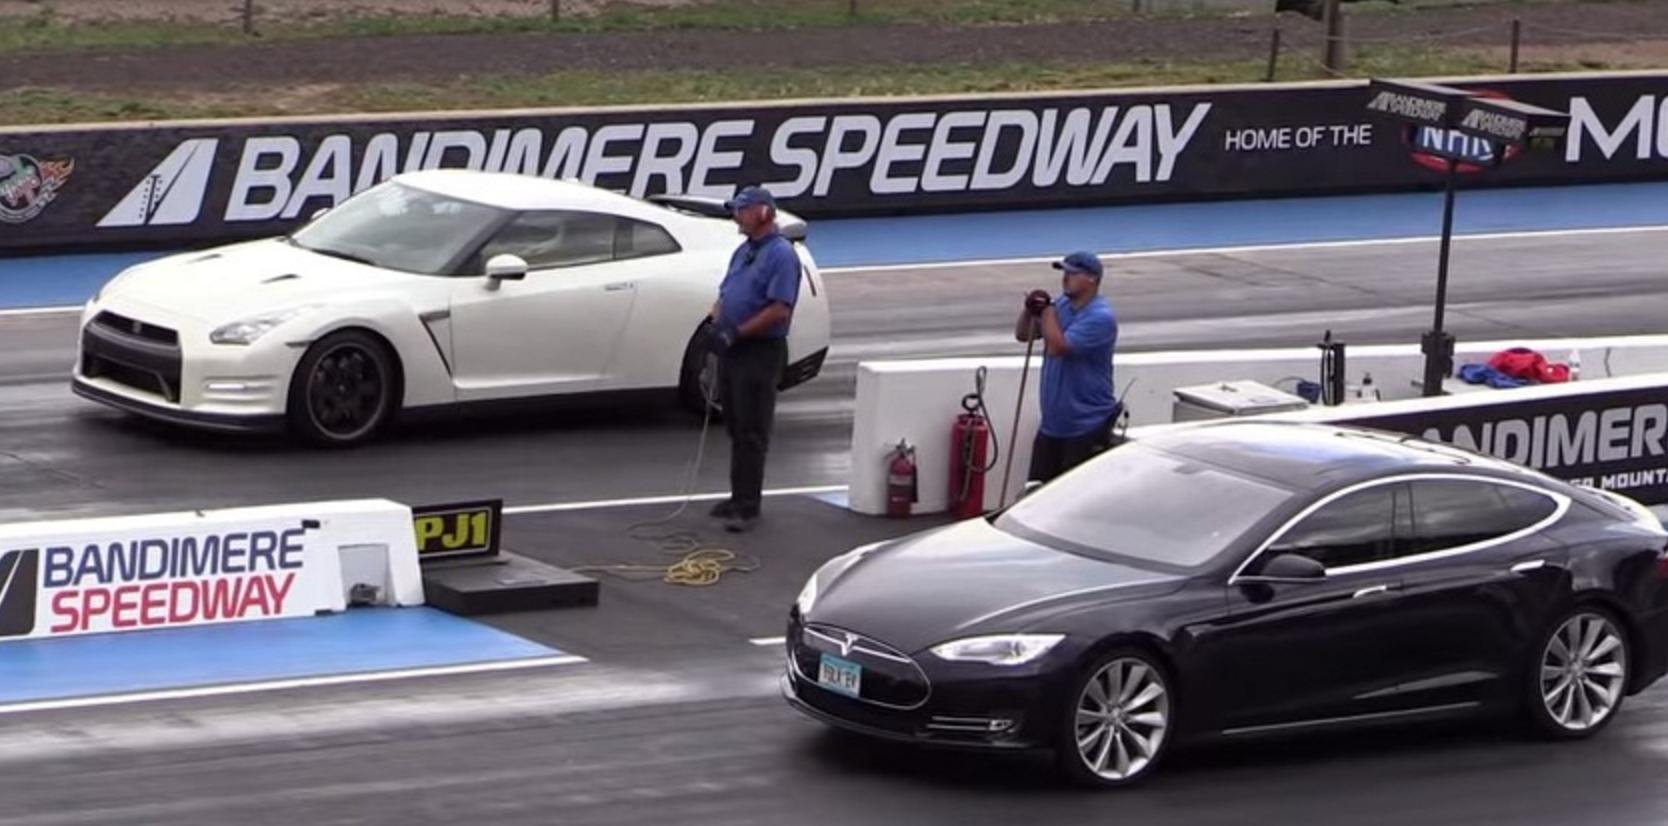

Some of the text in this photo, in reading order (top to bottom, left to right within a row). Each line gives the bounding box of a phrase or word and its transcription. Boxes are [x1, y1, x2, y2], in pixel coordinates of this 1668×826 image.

[763, 102, 1212, 198] SPEEDWAY
[1225, 124, 1373, 151] HOME OF THE
[1565, 94, 1668, 162] M
[1601, 468, 1668, 490] MOUNT
[43, 527, 305, 588] BANDIMERE
[415, 511, 487, 551] PJ1
[50, 572, 296, 633] SPEEDWAY
